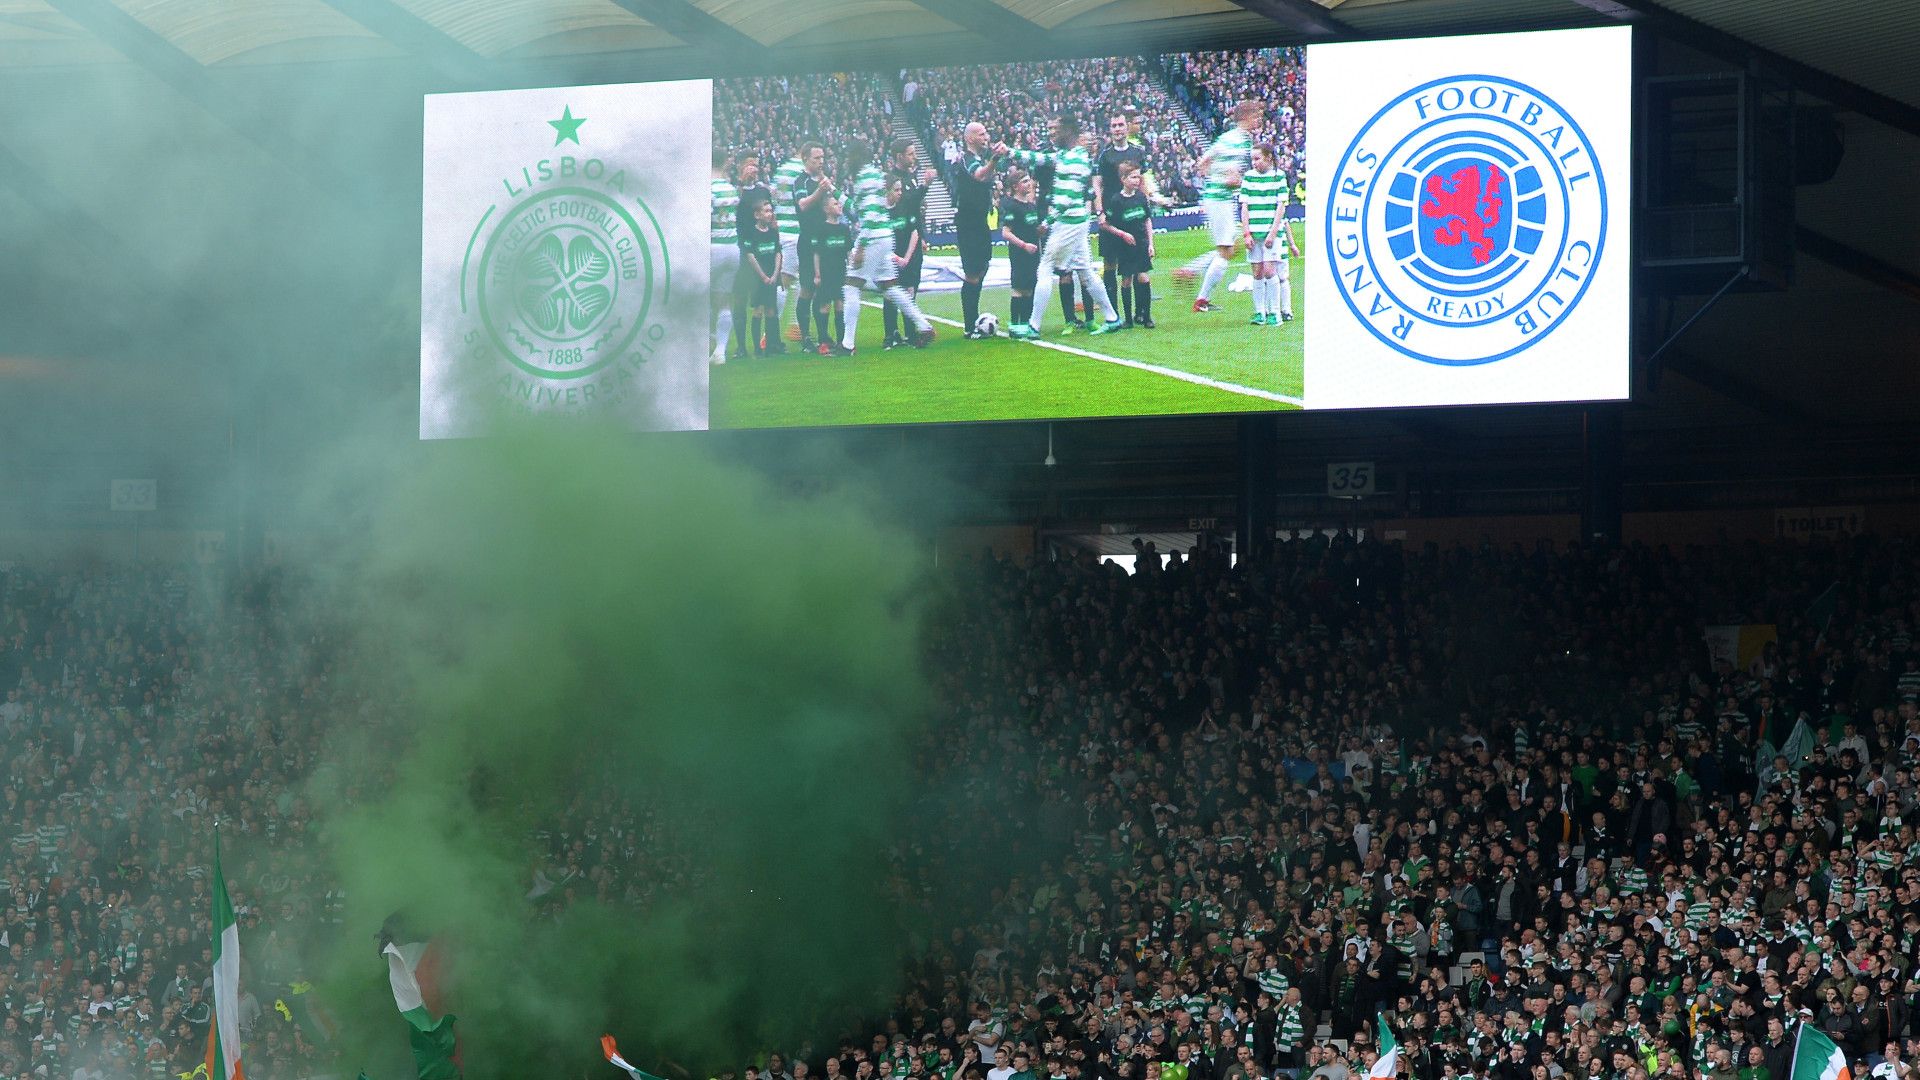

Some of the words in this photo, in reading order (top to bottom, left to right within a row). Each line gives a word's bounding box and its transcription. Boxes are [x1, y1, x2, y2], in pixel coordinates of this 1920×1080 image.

[503, 155, 627, 199] LISBOA
[1335, 147, 1415, 341] RANGERS
[1414, 85, 1591, 193] FOOTBALL
[1514, 239, 1592, 336] CLUB
[493, 254, 511, 288] THE
[503, 207, 547, 251] CELTIC
[548, 201, 619, 240] FOOTBALL
[615, 236, 638, 281] CLUB
[1426, 291, 1506, 320] READY
[496, 323, 666, 406] ANIVERSARIO
[547, 347, 583, 365] 1888
[1332, 467, 1369, 490] 35
[115, 482, 151, 505] 33
[1188, 518, 1217, 530] EXIT
[1789, 516, 1845, 532] TOILET
